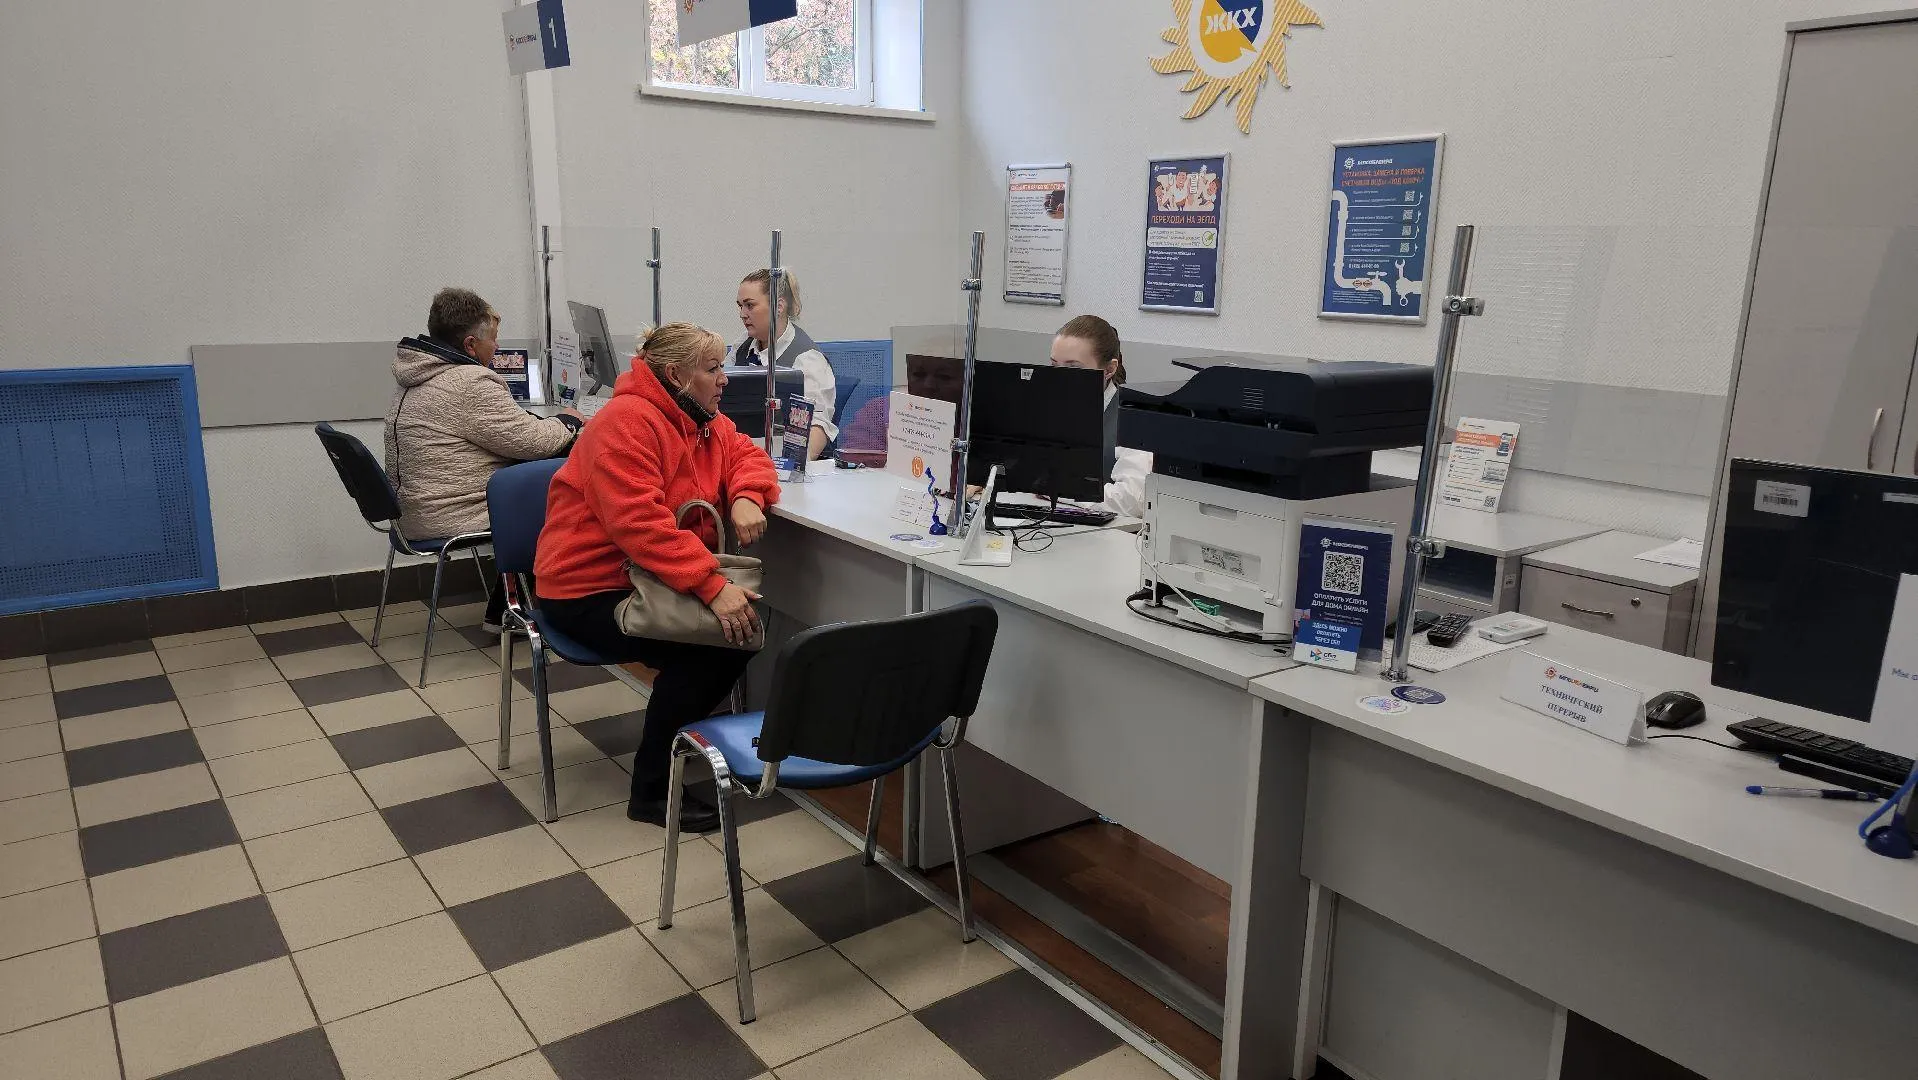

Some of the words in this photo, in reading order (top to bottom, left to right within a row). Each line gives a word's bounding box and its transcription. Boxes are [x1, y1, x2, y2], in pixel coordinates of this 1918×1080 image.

[1204, 6, 1258, 36] ЖКХ
[548, 17, 557, 49] 1
[1151, 215, 1185, 224] ПЕРЕХОДИ
[1186, 215, 1196, 224] НА
[1311, 600, 1324, 608] ДЛЯ
[1324, 601, 1343, 611] ДОМА
[1313, 592, 1345, 603] ОПЛАТИТЬ
[1345, 596, 1368, 606] УСЛУГИ
[1328, 624, 1348, 633] МОЖНО
[1540, 684, 1603, 715] ТЕХНИЧЕСКИЙ
[1547, 702, 1587, 723] ПЕРЕРЫВ
